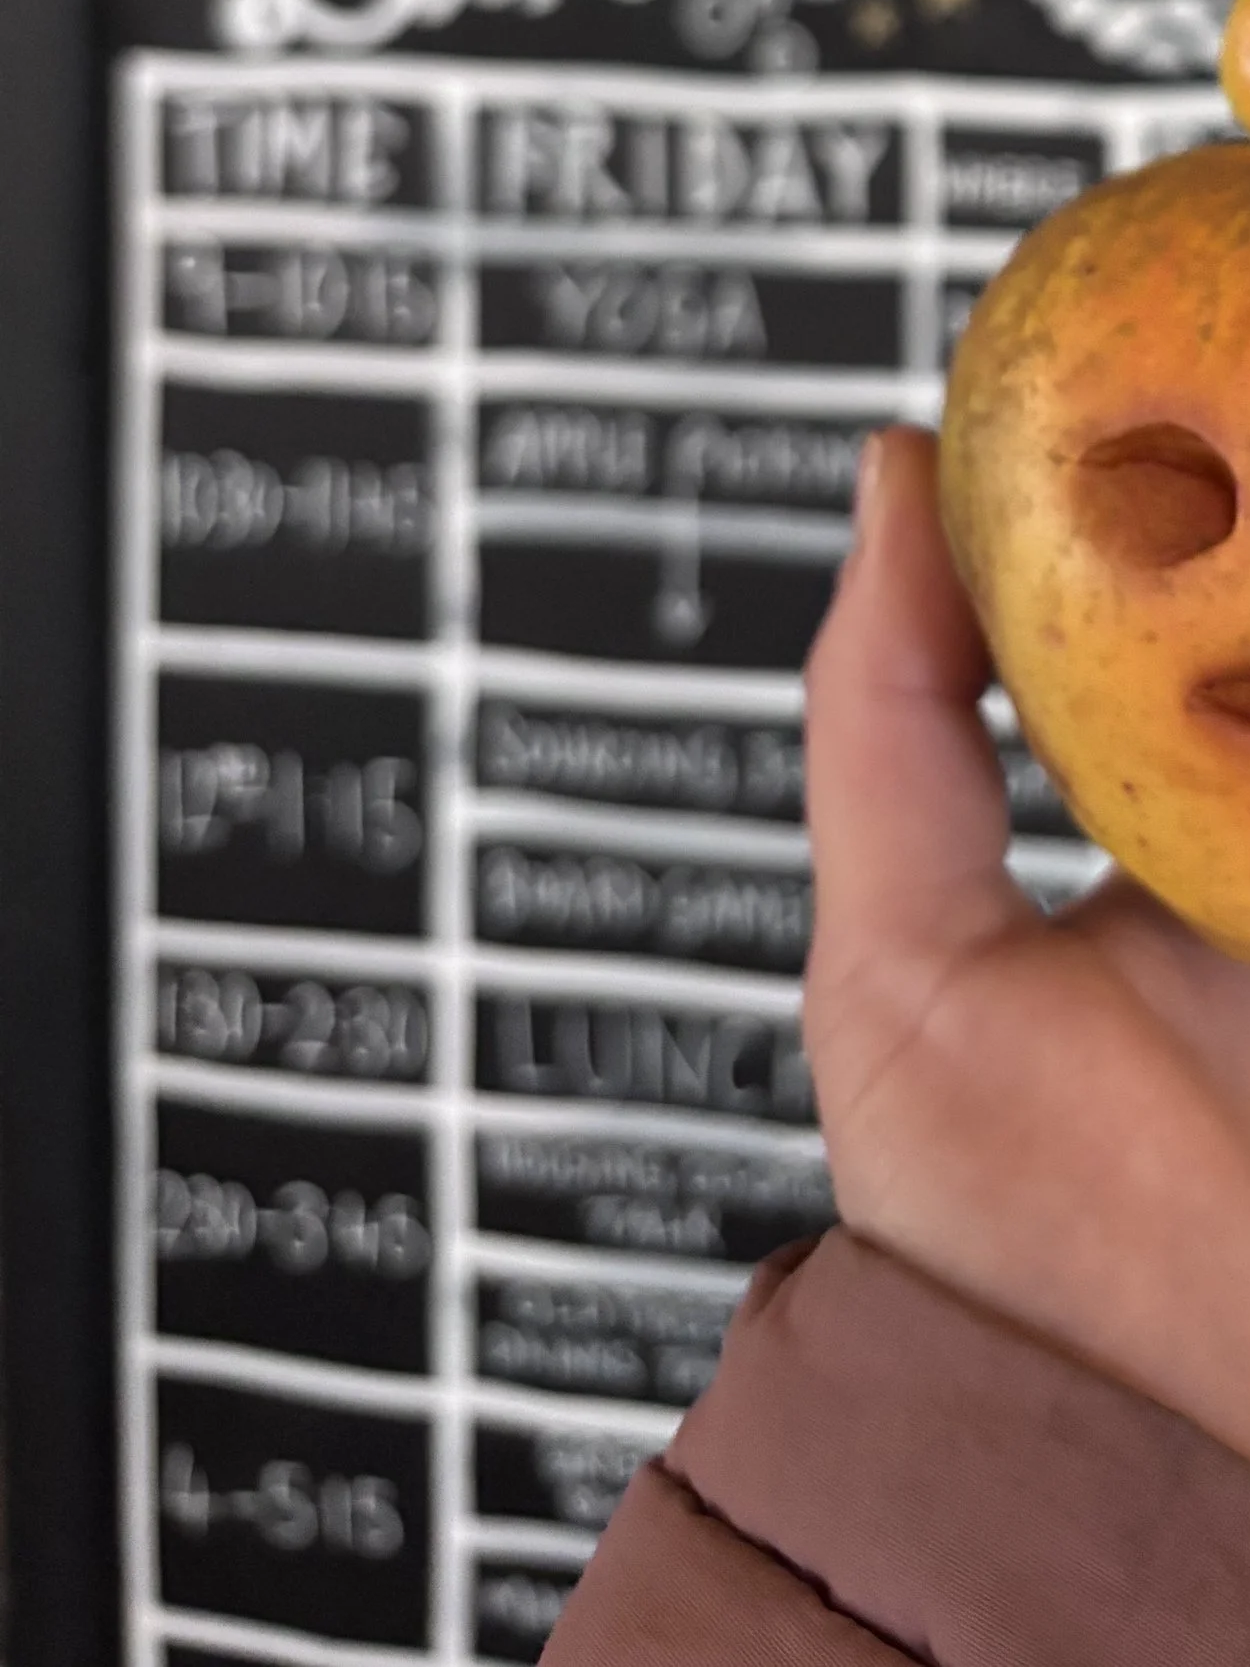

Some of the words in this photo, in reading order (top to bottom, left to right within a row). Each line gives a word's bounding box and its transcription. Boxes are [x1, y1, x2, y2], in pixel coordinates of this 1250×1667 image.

[165, 96, 408, 202] TIME
[484, 102, 888, 222] FRIDAY
[540, 262, 767, 358] YOGA
